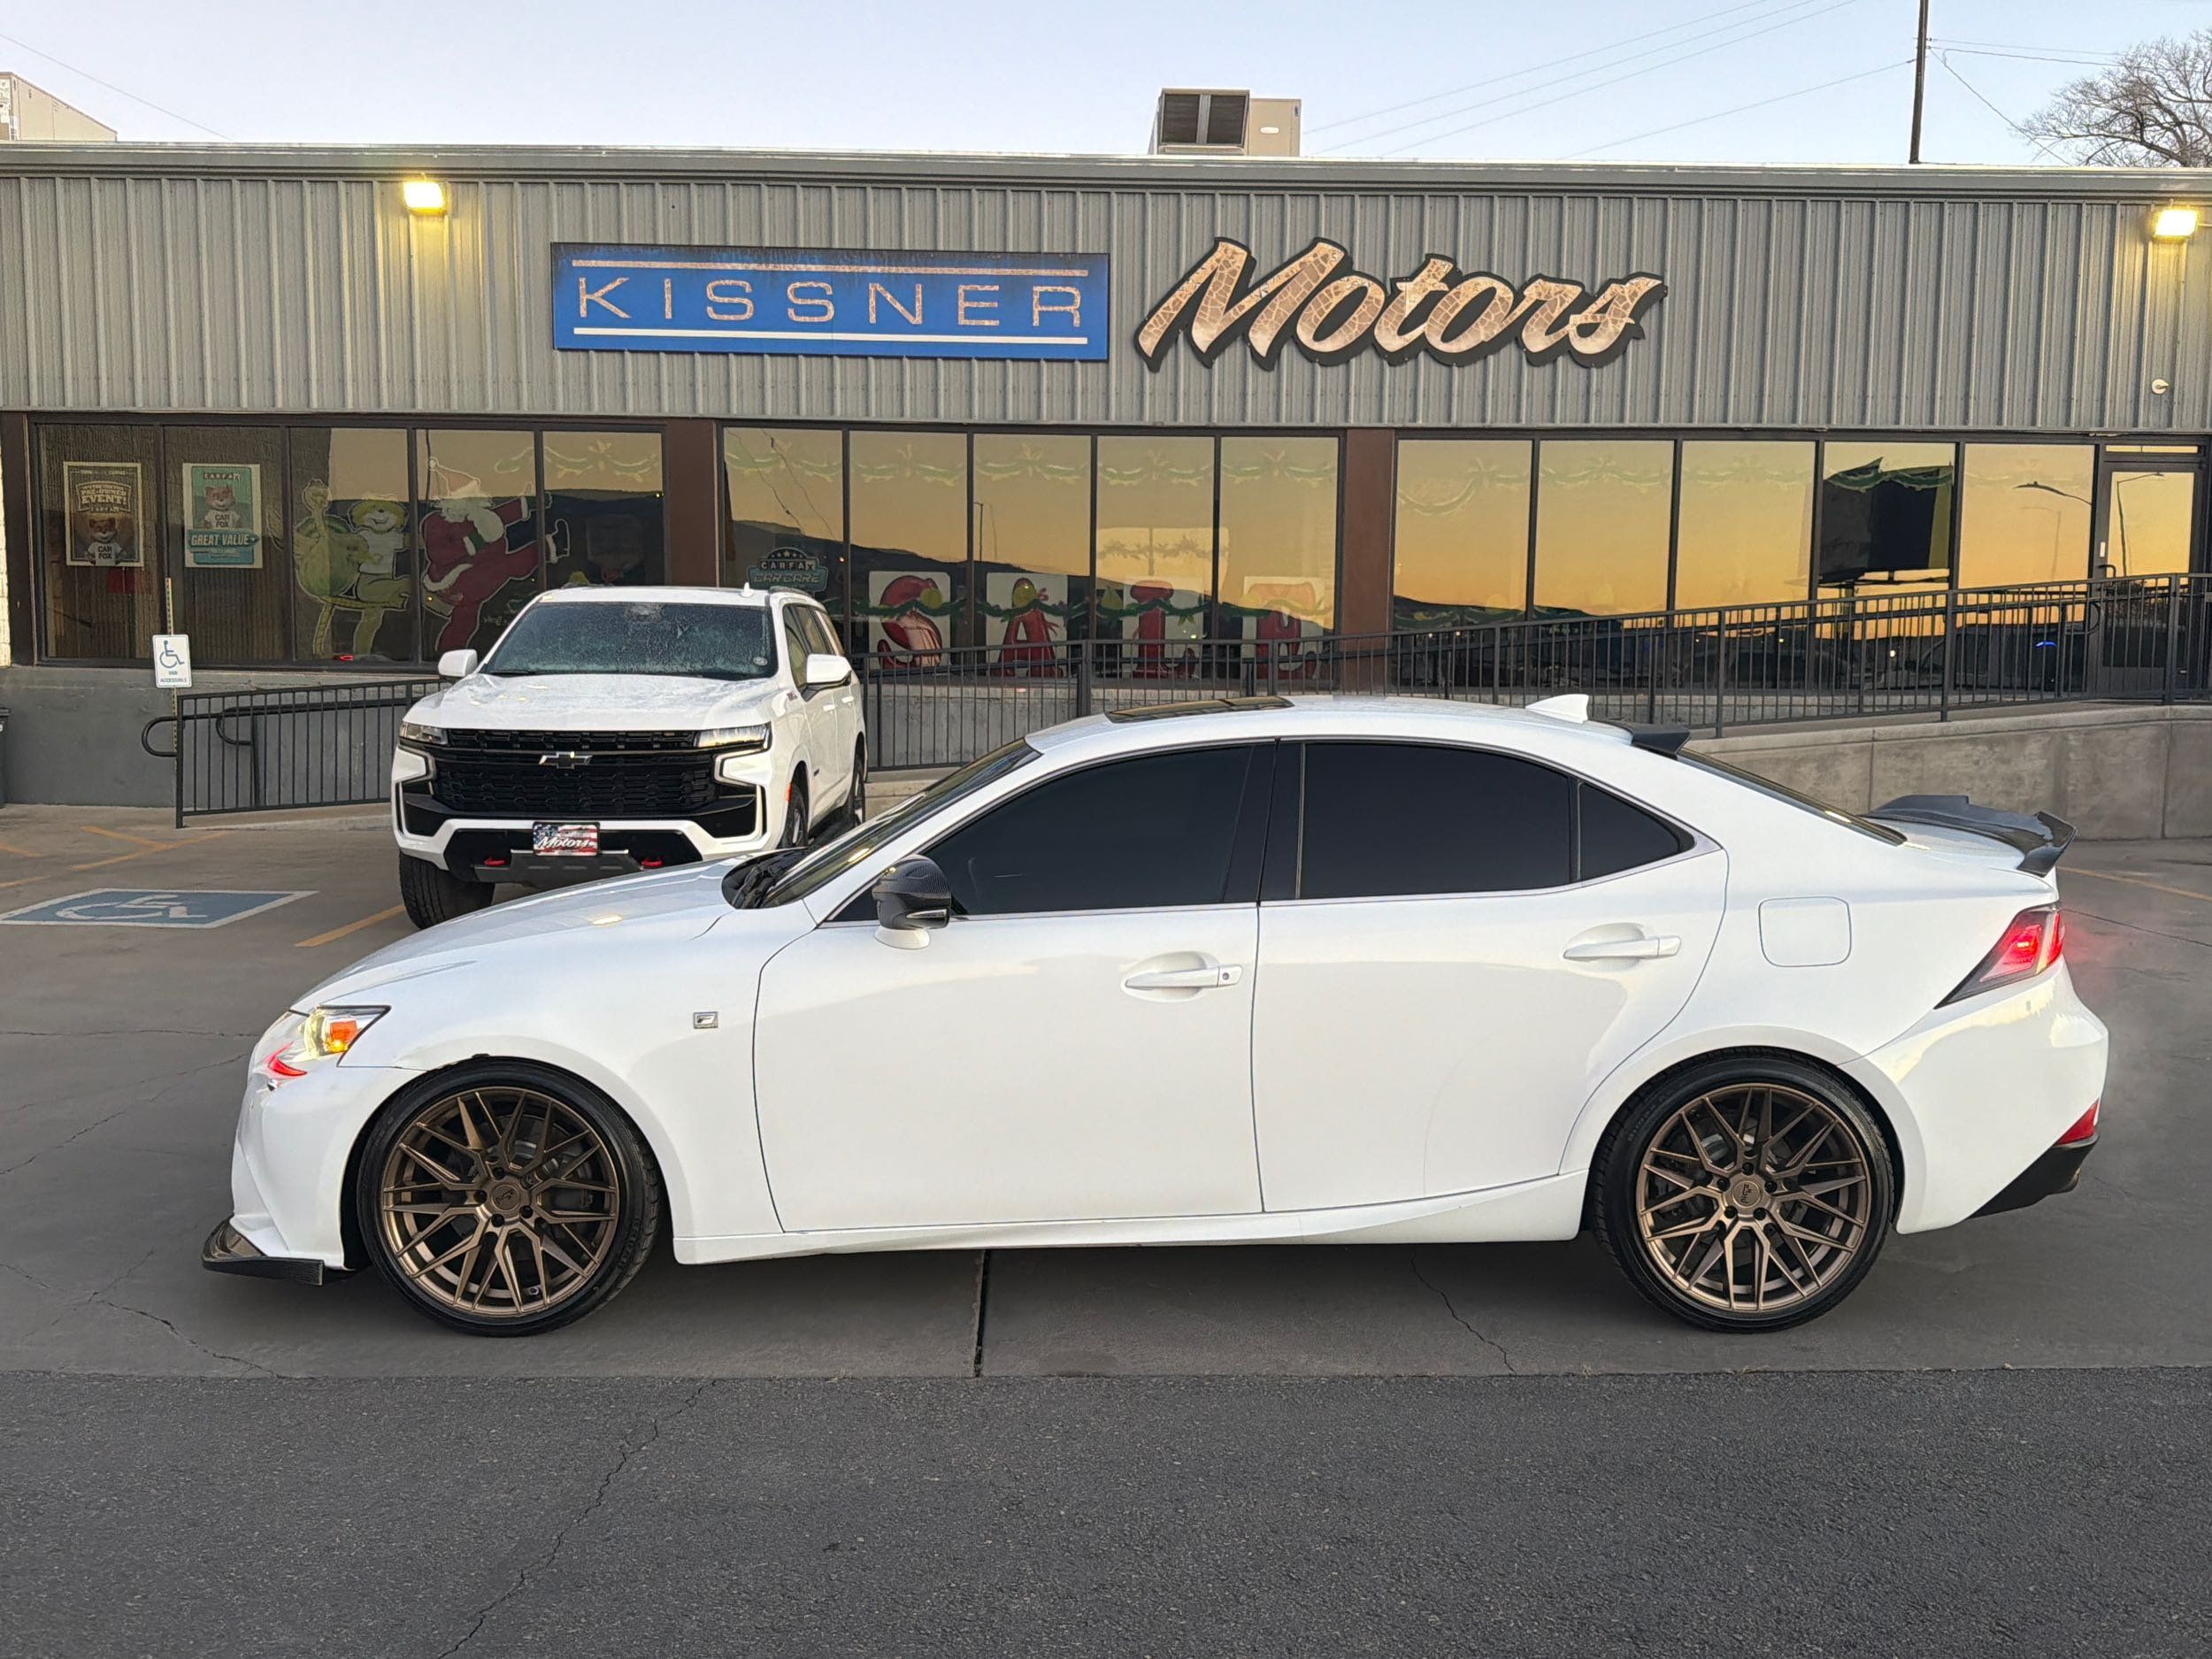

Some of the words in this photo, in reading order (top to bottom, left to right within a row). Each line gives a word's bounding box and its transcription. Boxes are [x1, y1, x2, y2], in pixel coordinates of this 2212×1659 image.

[580, 276, 1082, 327] KISSNER
[1133, 239, 1665, 361] Motors
[204, 472, 241, 480] CARFAX
[81, 495, 127, 505] EVENT!
[191, 534, 219, 546] GREAT
[222, 534, 250, 545] VALUE
[760, 560, 817, 570] CARFAX
[537, 835, 590, 849] Motors
